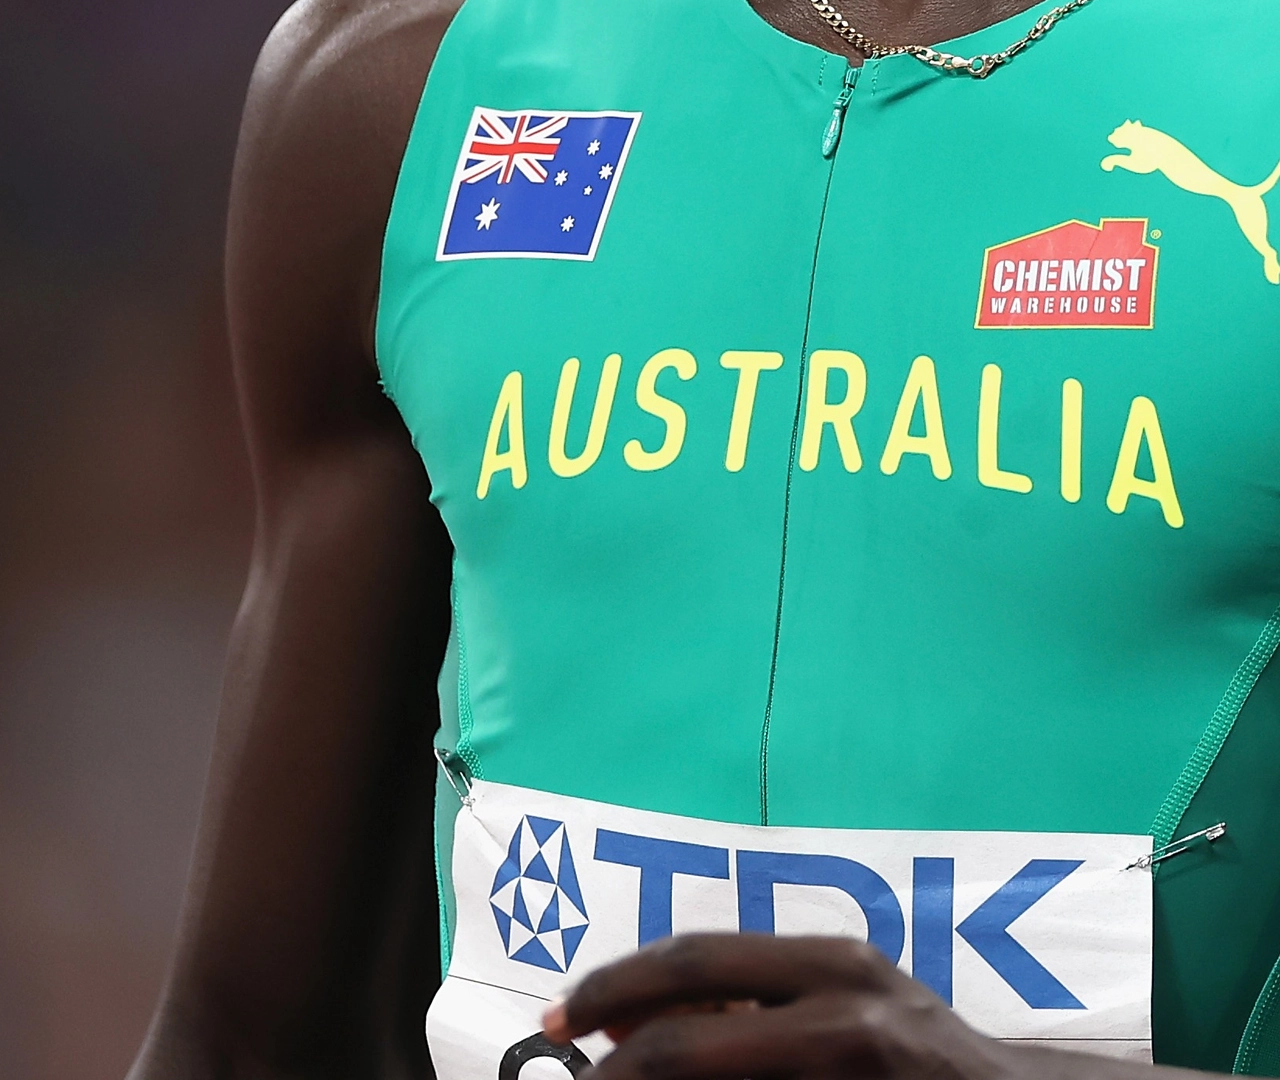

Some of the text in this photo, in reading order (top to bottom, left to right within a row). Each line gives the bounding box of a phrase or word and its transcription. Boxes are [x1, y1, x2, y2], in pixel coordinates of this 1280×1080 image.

[992, 258, 1146, 292] CHEMIST
[990, 296, 1137, 314] WAREHOUSE
[476, 348, 1184, 529] AUSTRALIA
